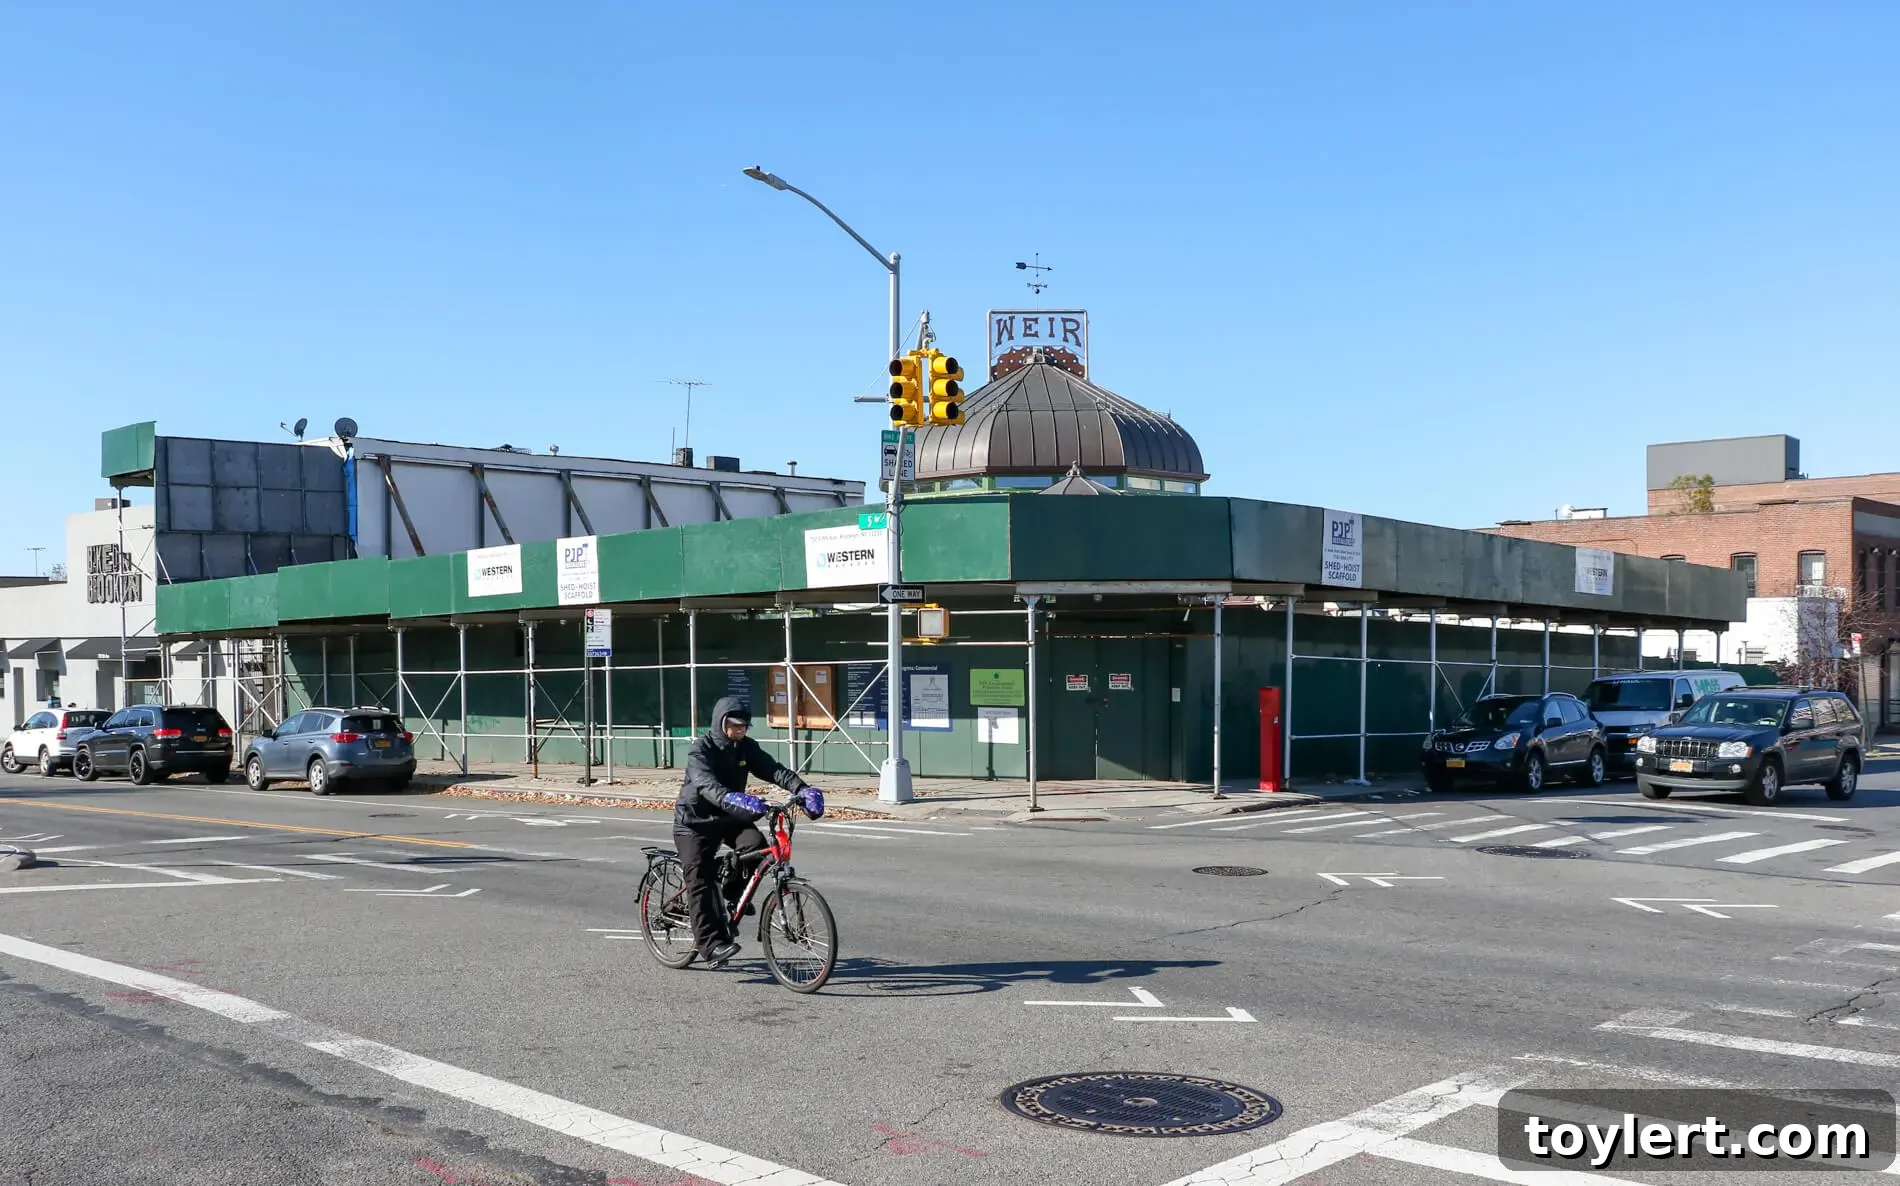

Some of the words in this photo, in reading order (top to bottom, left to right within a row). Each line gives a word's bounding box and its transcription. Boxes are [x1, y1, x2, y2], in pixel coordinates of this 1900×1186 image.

[996, 316, 1082, 347] WEIR
[884, 459, 913, 468] SHED
[889, 469, 909, 478] LE
[868, 516, 874, 528] 5
[1331, 520, 1352, 540] PJP
[564, 548, 584, 562] PJP
[826, 549, 876, 563] WESTERN
[481, 565, 513, 577] WESTERN
[1328, 570, 1357, 582] SCAFFOLD
[88, 574, 142, 603] BROOKYN
[892, 590, 906, 599] ONE
[907, 590, 921, 599] WAY
[564, 590, 594, 601] SCAFFOLD
